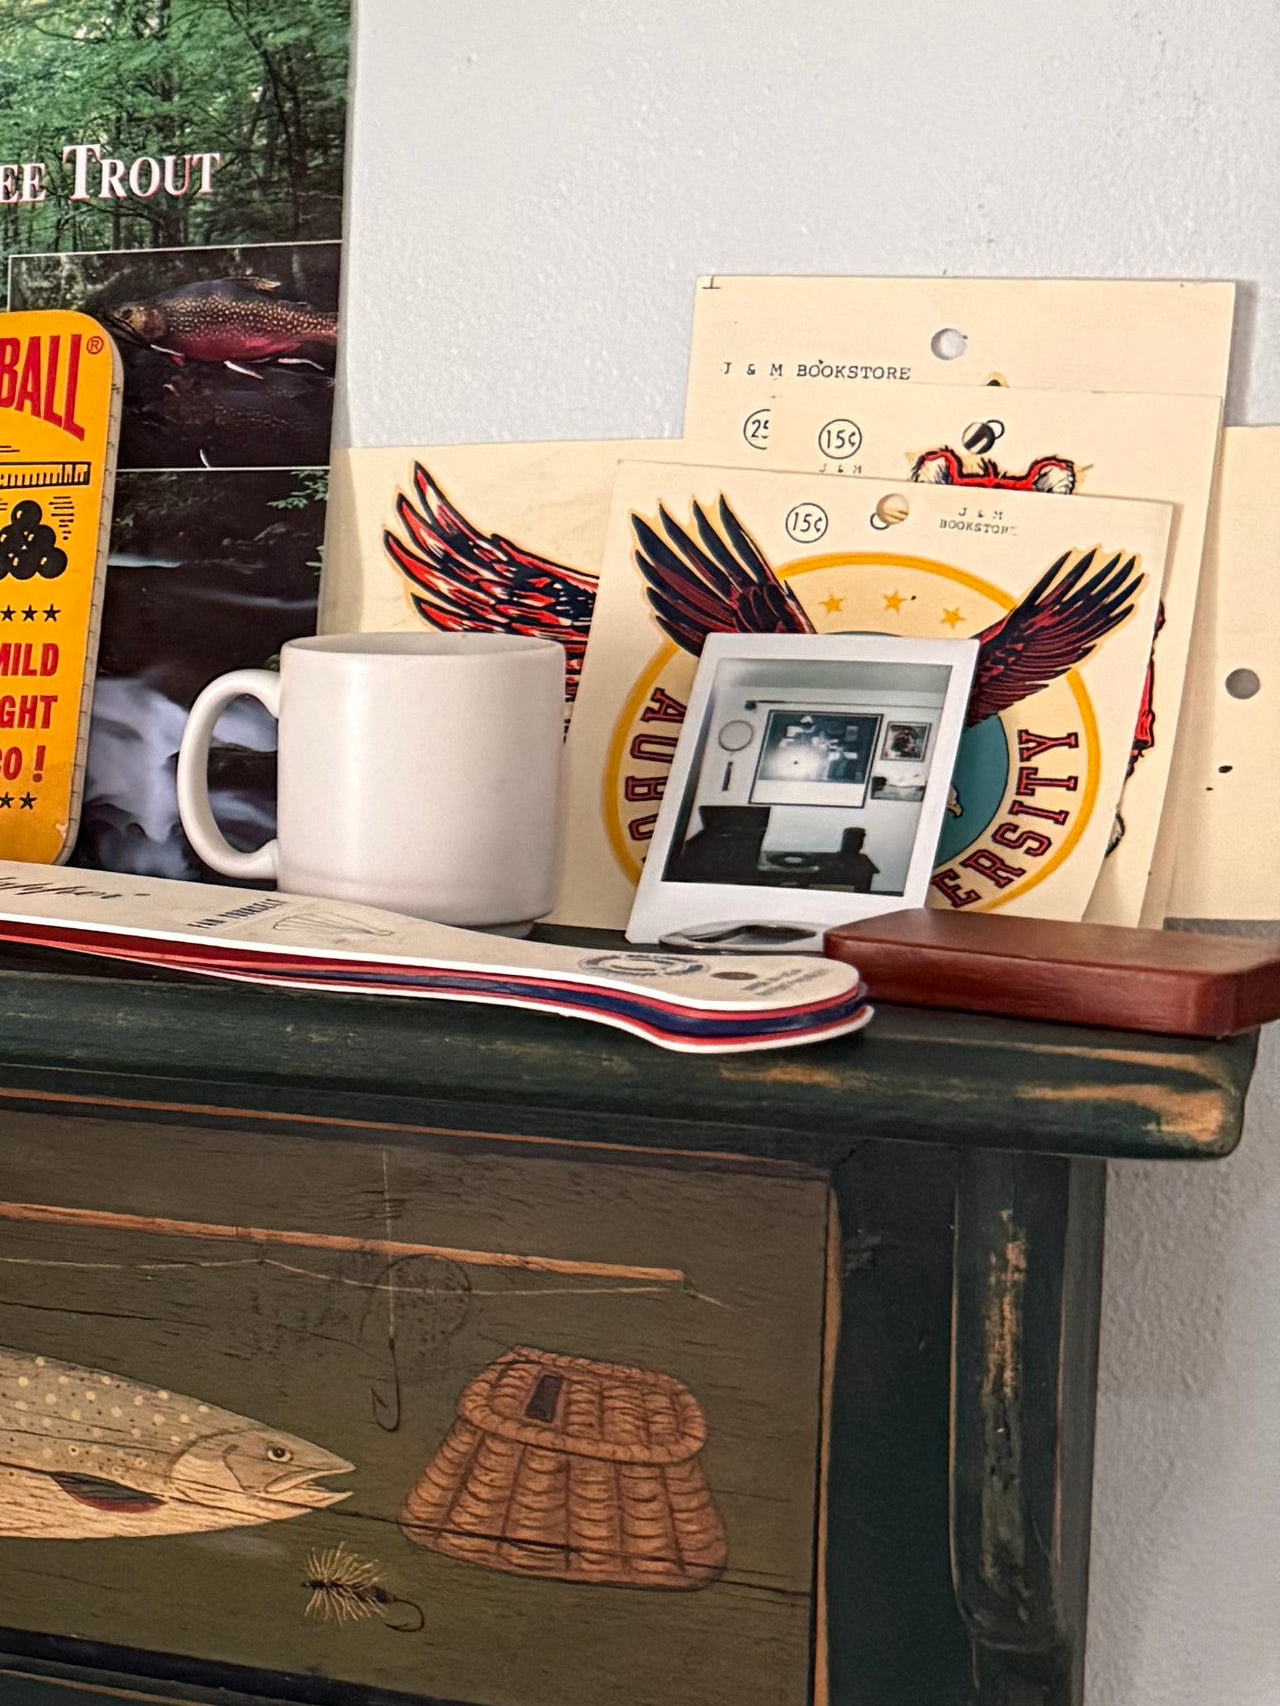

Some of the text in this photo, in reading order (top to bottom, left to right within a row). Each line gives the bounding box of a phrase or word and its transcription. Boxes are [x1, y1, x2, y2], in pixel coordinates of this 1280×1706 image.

[722, 362, 912, 381] J & M BOOKSTORE
[930, 729, 1080, 909] ERSITY
